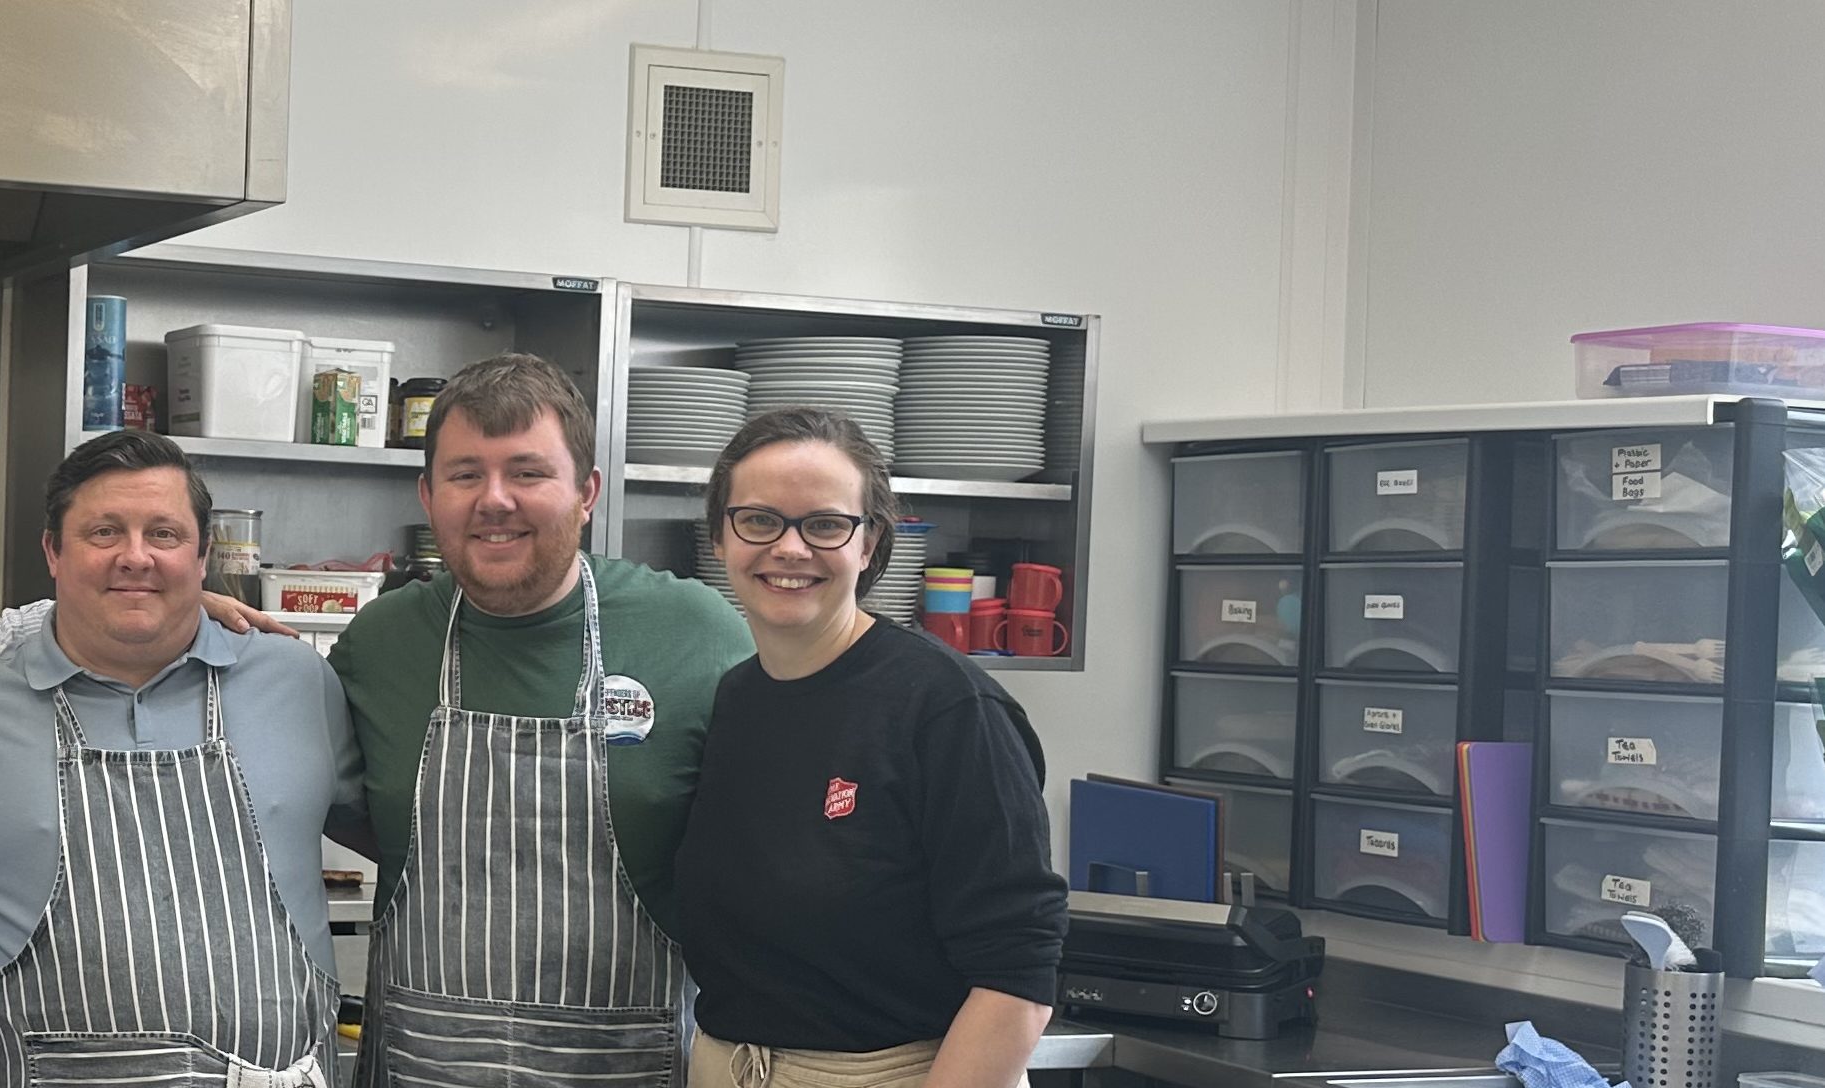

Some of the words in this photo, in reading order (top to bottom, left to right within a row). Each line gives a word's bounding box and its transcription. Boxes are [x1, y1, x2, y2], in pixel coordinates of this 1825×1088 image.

[556, 279, 594, 290] MOFFAT
[1044, 315, 1078, 326] MOFFAT
[1623, 476, 1644, 485] Food
[1623, 487, 1644, 498] Bags
[297, 594, 318, 604] SOFT
[1615, 739, 1636, 750] Tea
[1612, 751, 1644, 762] Towels
[1612, 879, 1632, 891] Tea
